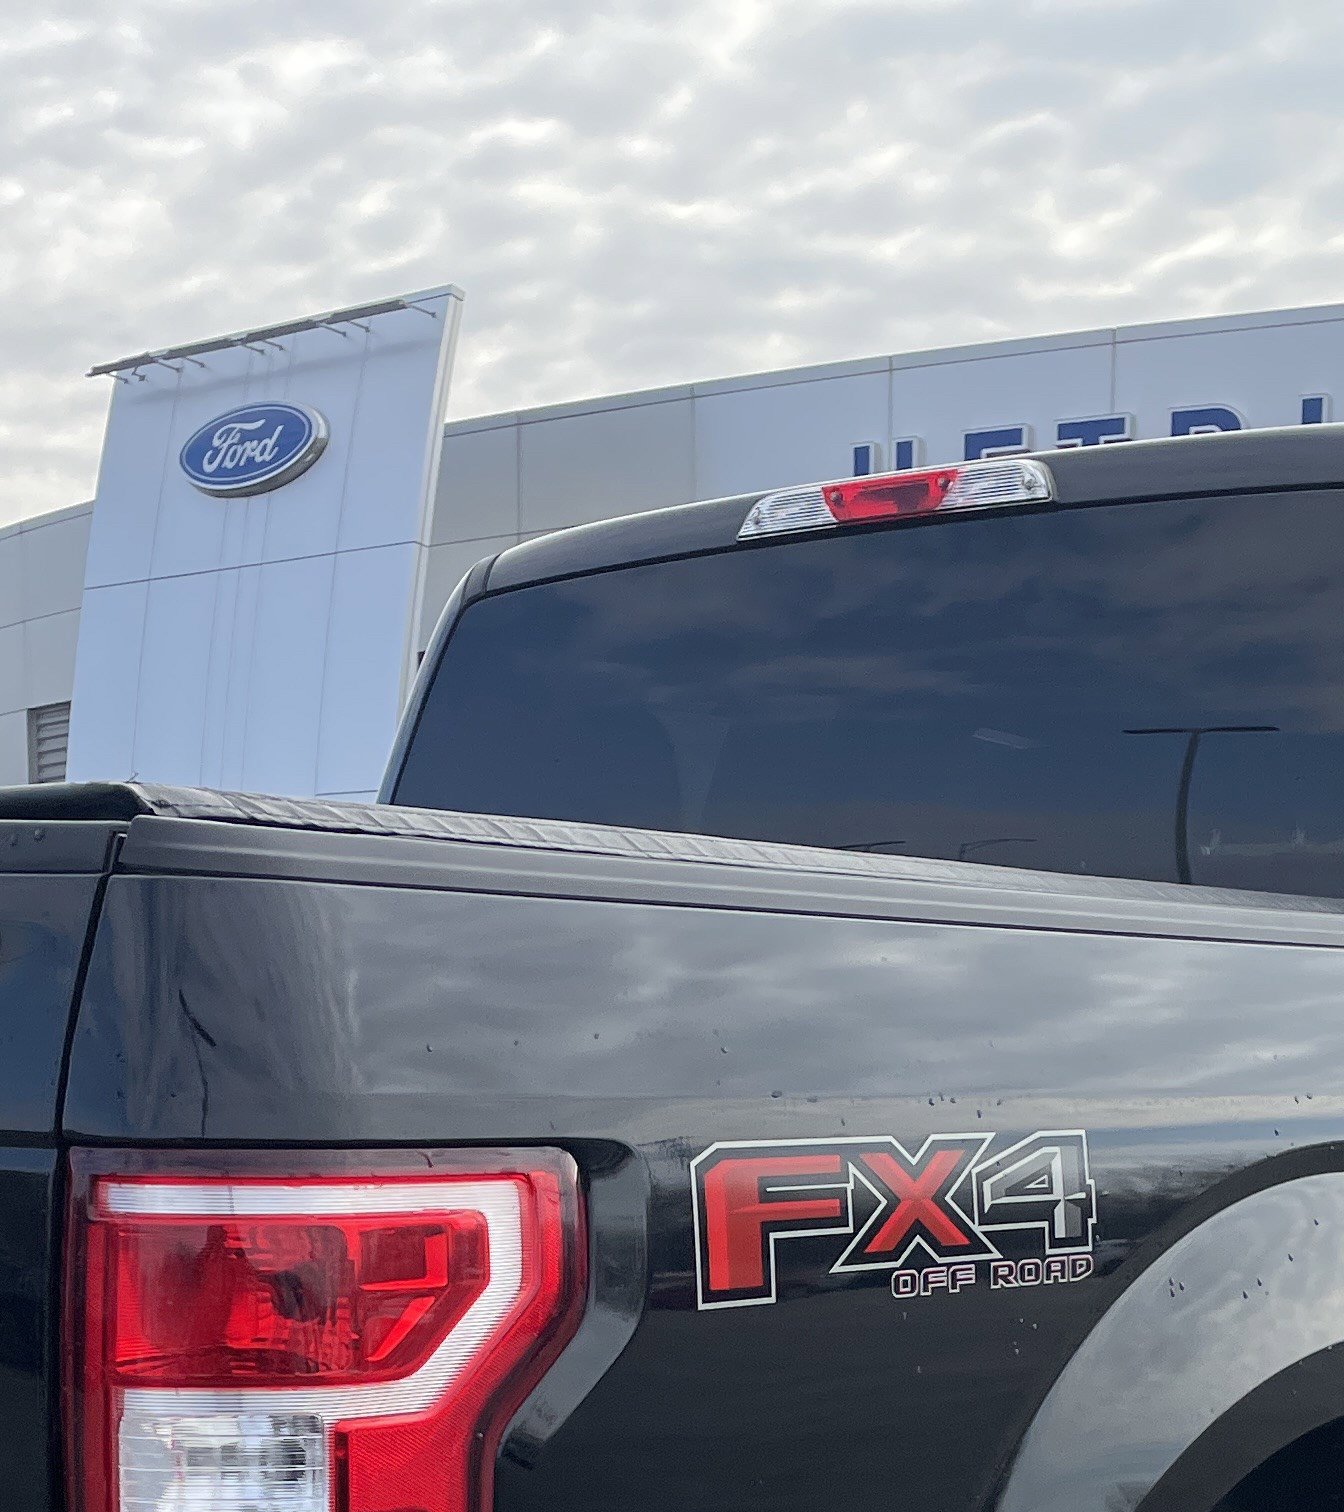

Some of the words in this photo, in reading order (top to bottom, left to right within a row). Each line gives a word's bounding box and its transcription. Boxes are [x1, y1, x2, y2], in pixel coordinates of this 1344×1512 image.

[202, 418, 284, 473] Ford
[690, 1129, 1097, 1310] FX4
[891, 1263, 976, 1299] OFF
[990, 1253, 1093, 1290] ROAD
